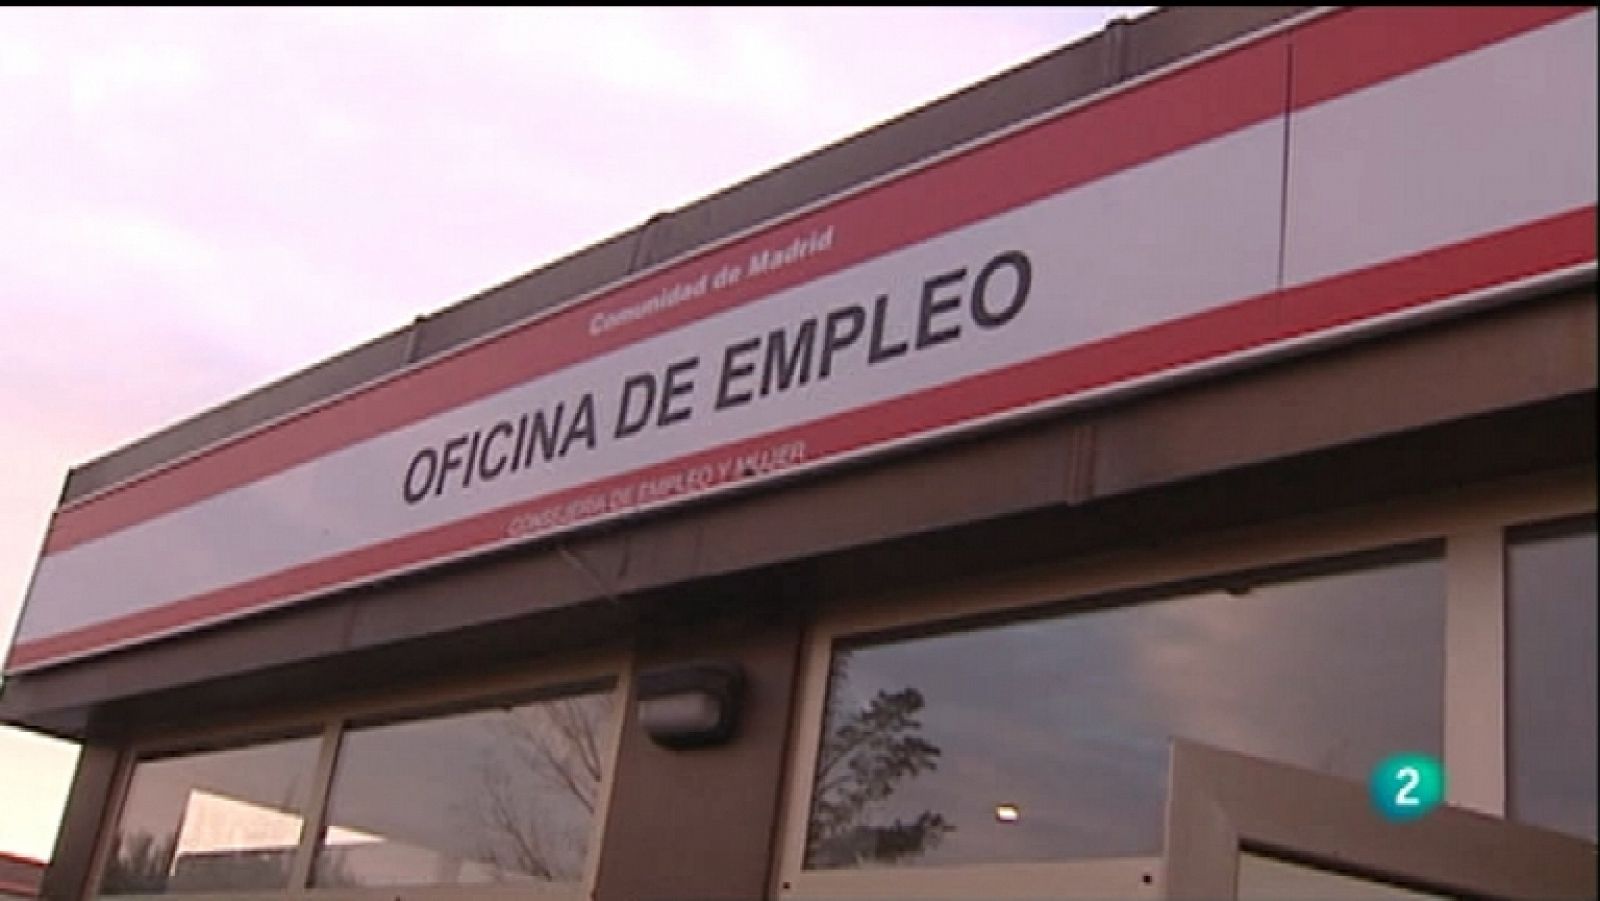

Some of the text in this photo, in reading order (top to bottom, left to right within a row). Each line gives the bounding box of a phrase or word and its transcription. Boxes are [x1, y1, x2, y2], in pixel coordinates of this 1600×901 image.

[589, 226, 835, 336] Comunidad de Madrid
[402, 250, 1033, 505] OFICINA DE EMPLEO
[605, 484, 636, 513] DE
[636, 464, 714, 507] EMPLEO
[734, 440, 808, 477] MUJER
